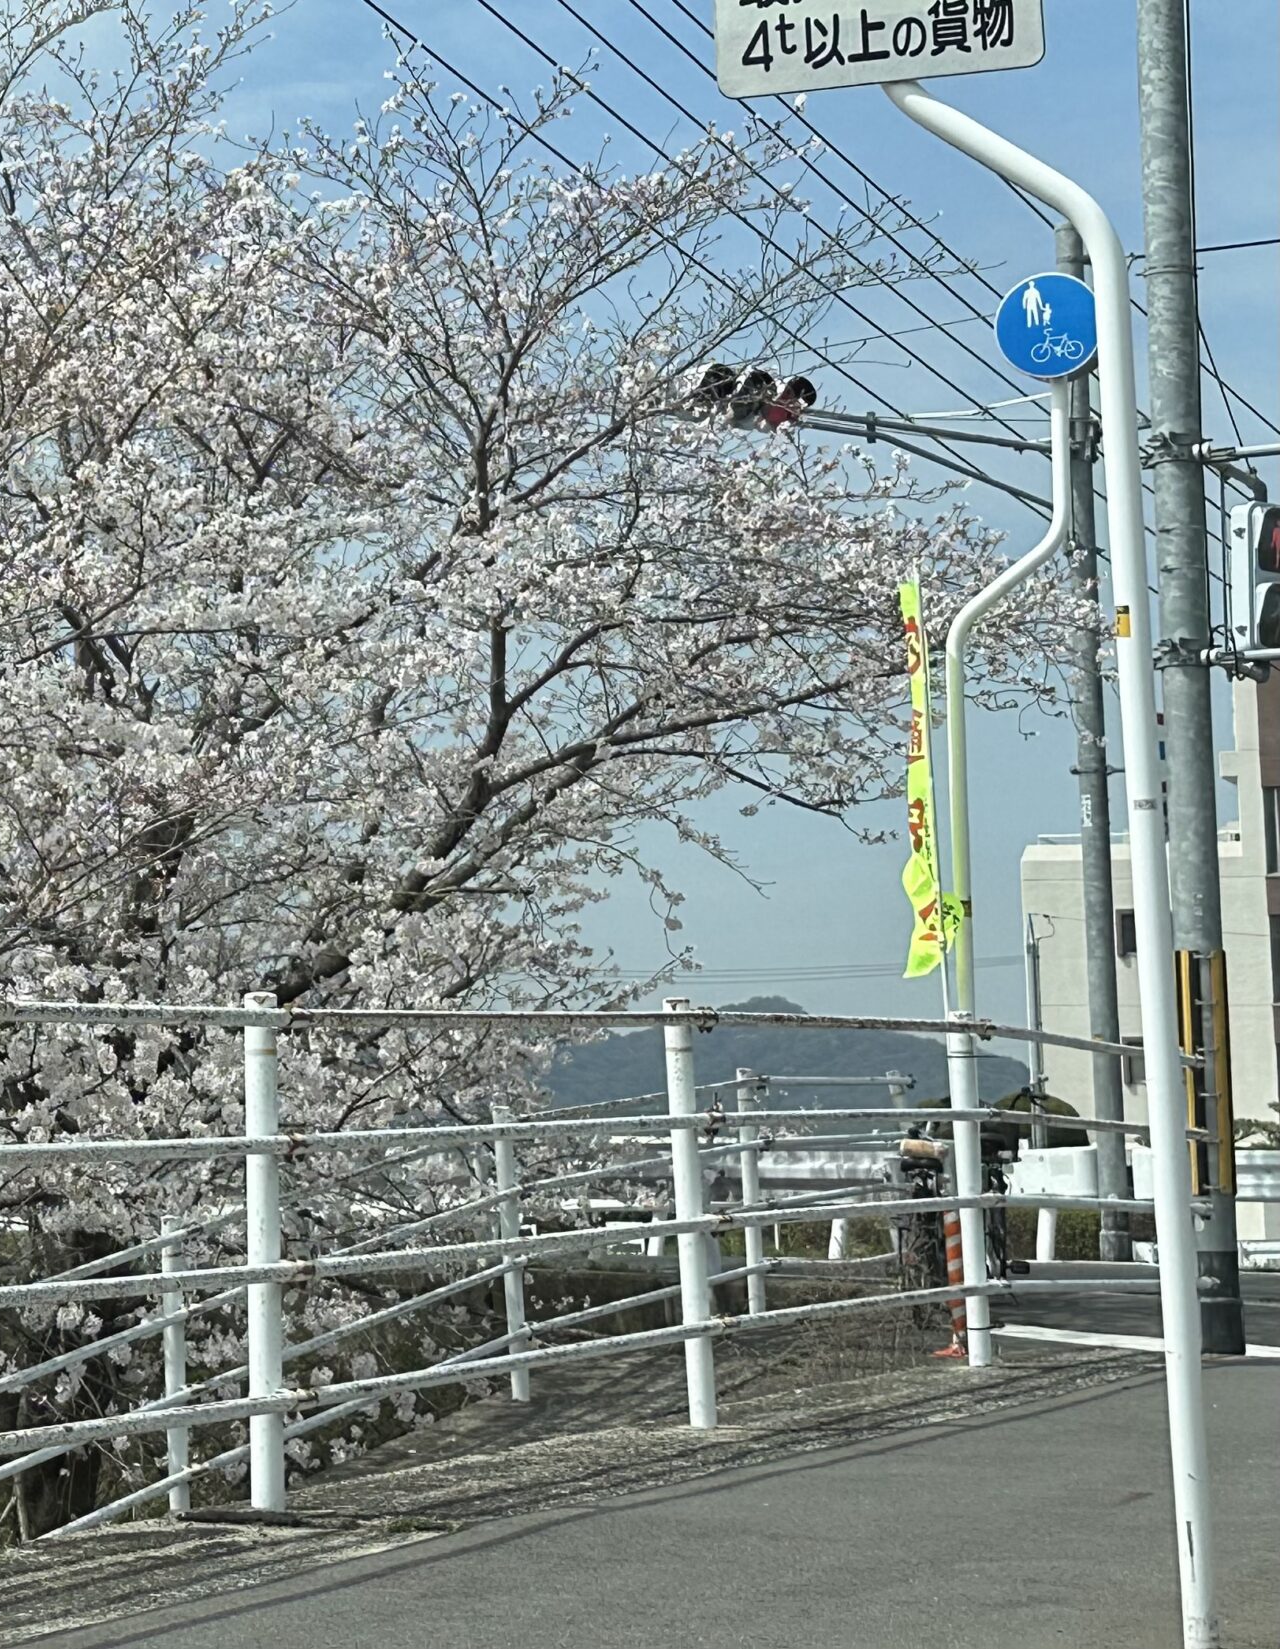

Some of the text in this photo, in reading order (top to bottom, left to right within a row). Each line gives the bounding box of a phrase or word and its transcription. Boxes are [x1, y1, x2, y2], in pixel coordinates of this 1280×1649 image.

[741, 0, 1014, 72] 4t以上の貨物
